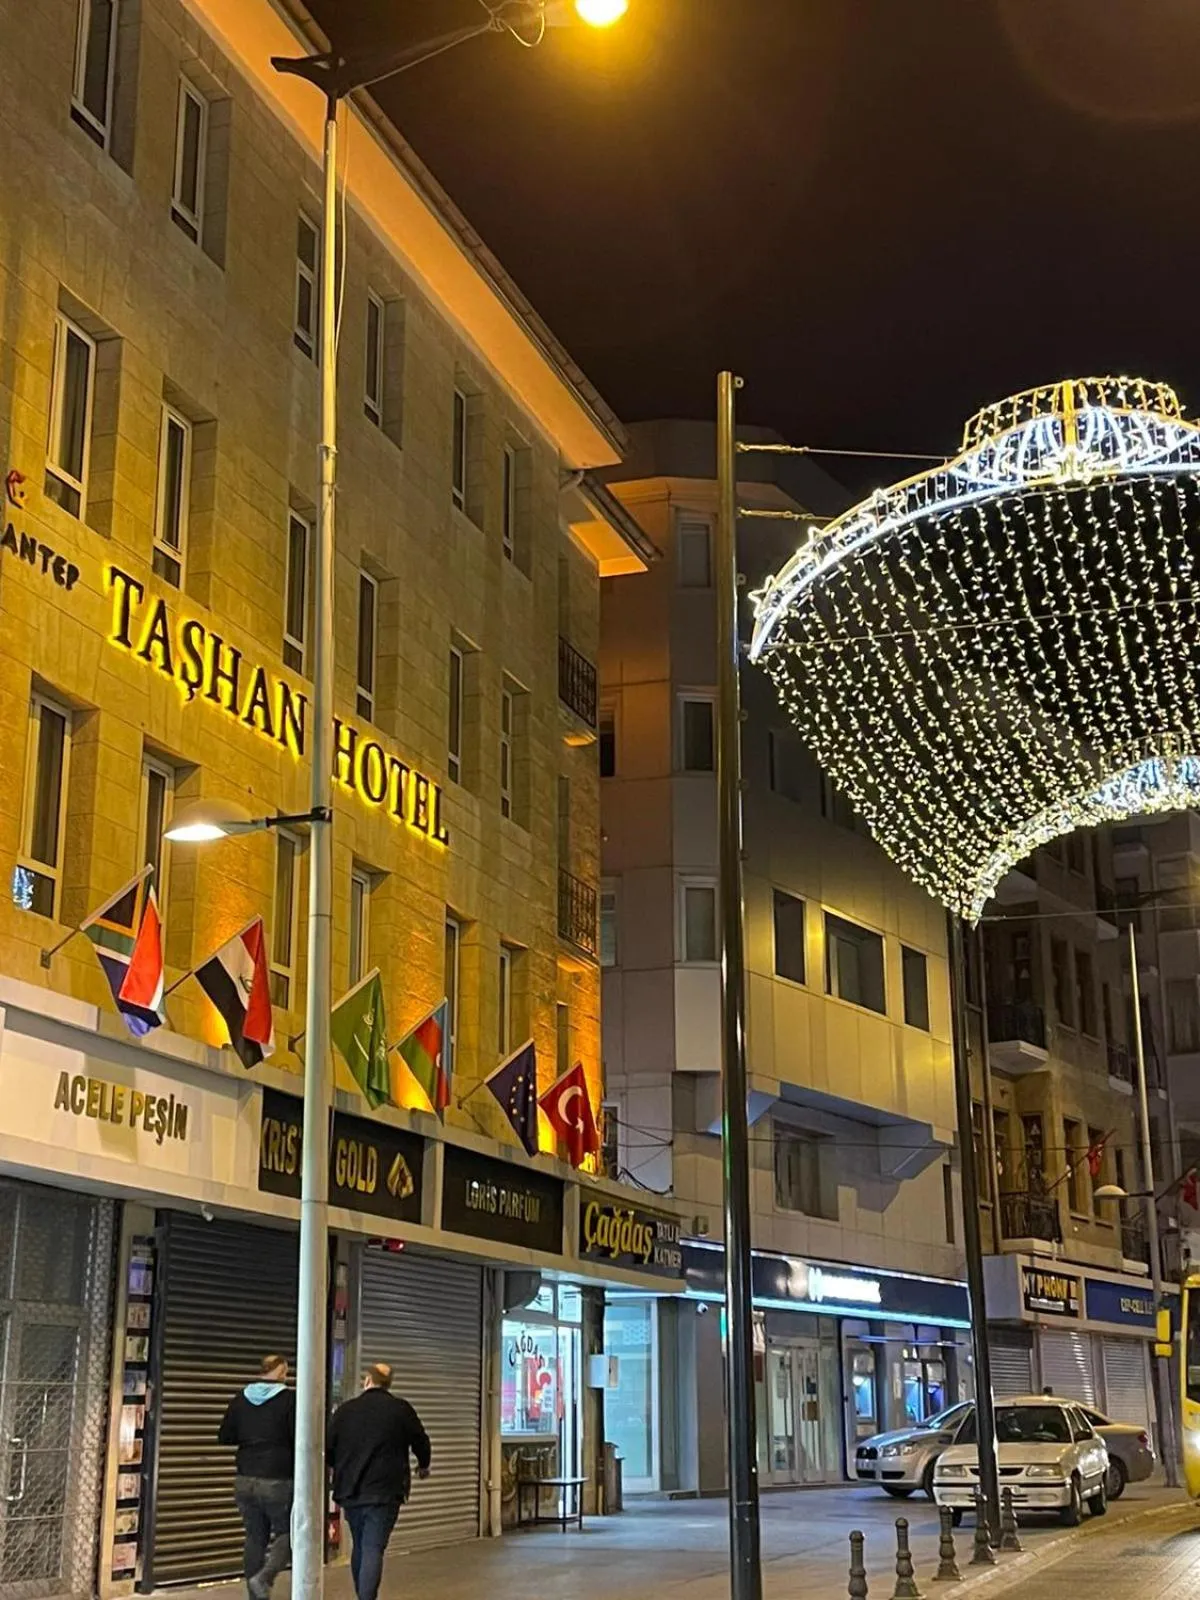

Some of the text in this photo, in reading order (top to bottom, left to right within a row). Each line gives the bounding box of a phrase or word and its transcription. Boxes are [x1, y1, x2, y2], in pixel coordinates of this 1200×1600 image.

[105, 565, 449, 847] TAŞHAN HOTEL
[54, 1071, 188, 1146] ACELE PEŞİN
[335, 1137, 378, 1194] GOLD
[584, 1201, 654, 1265] Çağdaş
